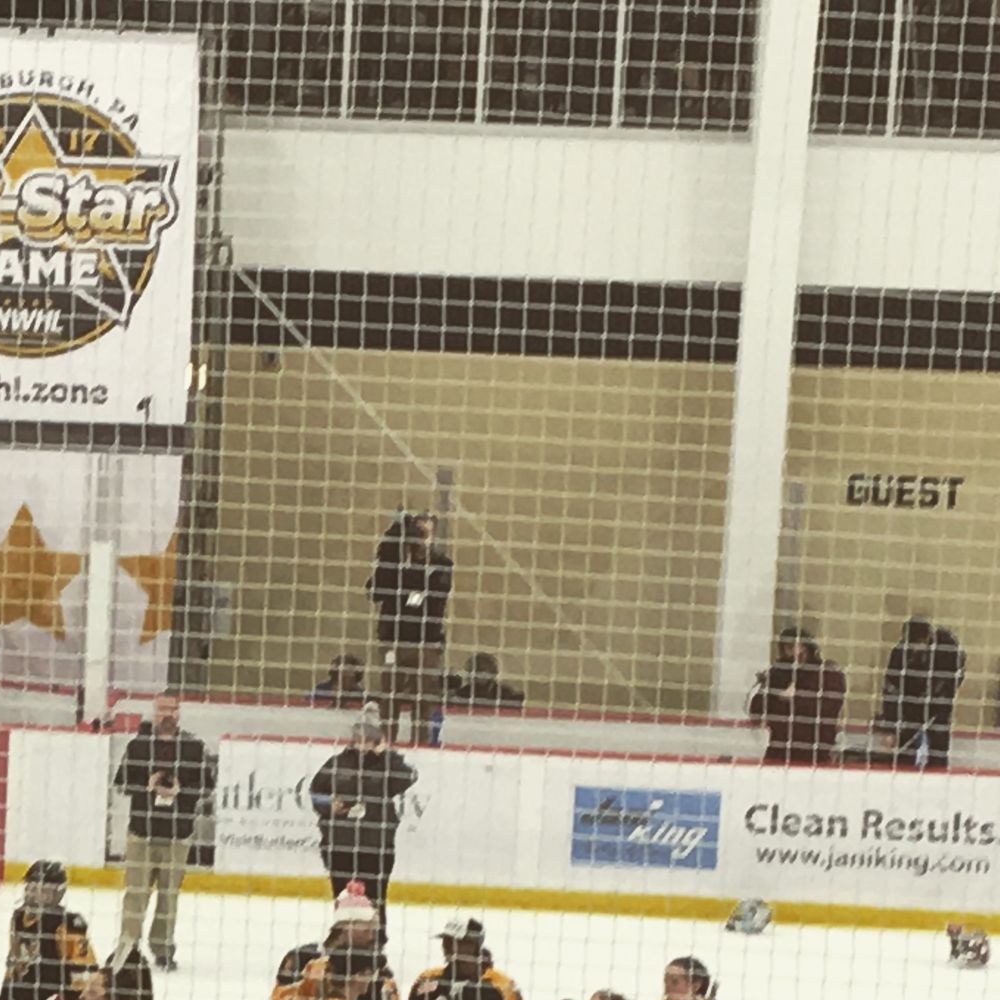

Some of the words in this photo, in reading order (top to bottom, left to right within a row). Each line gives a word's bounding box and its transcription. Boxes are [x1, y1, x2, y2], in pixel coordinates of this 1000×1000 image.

[108, 96, 140, 131] PA
[846, 473, 966, 511] GUEST
[745, 803, 848, 838] Clean
